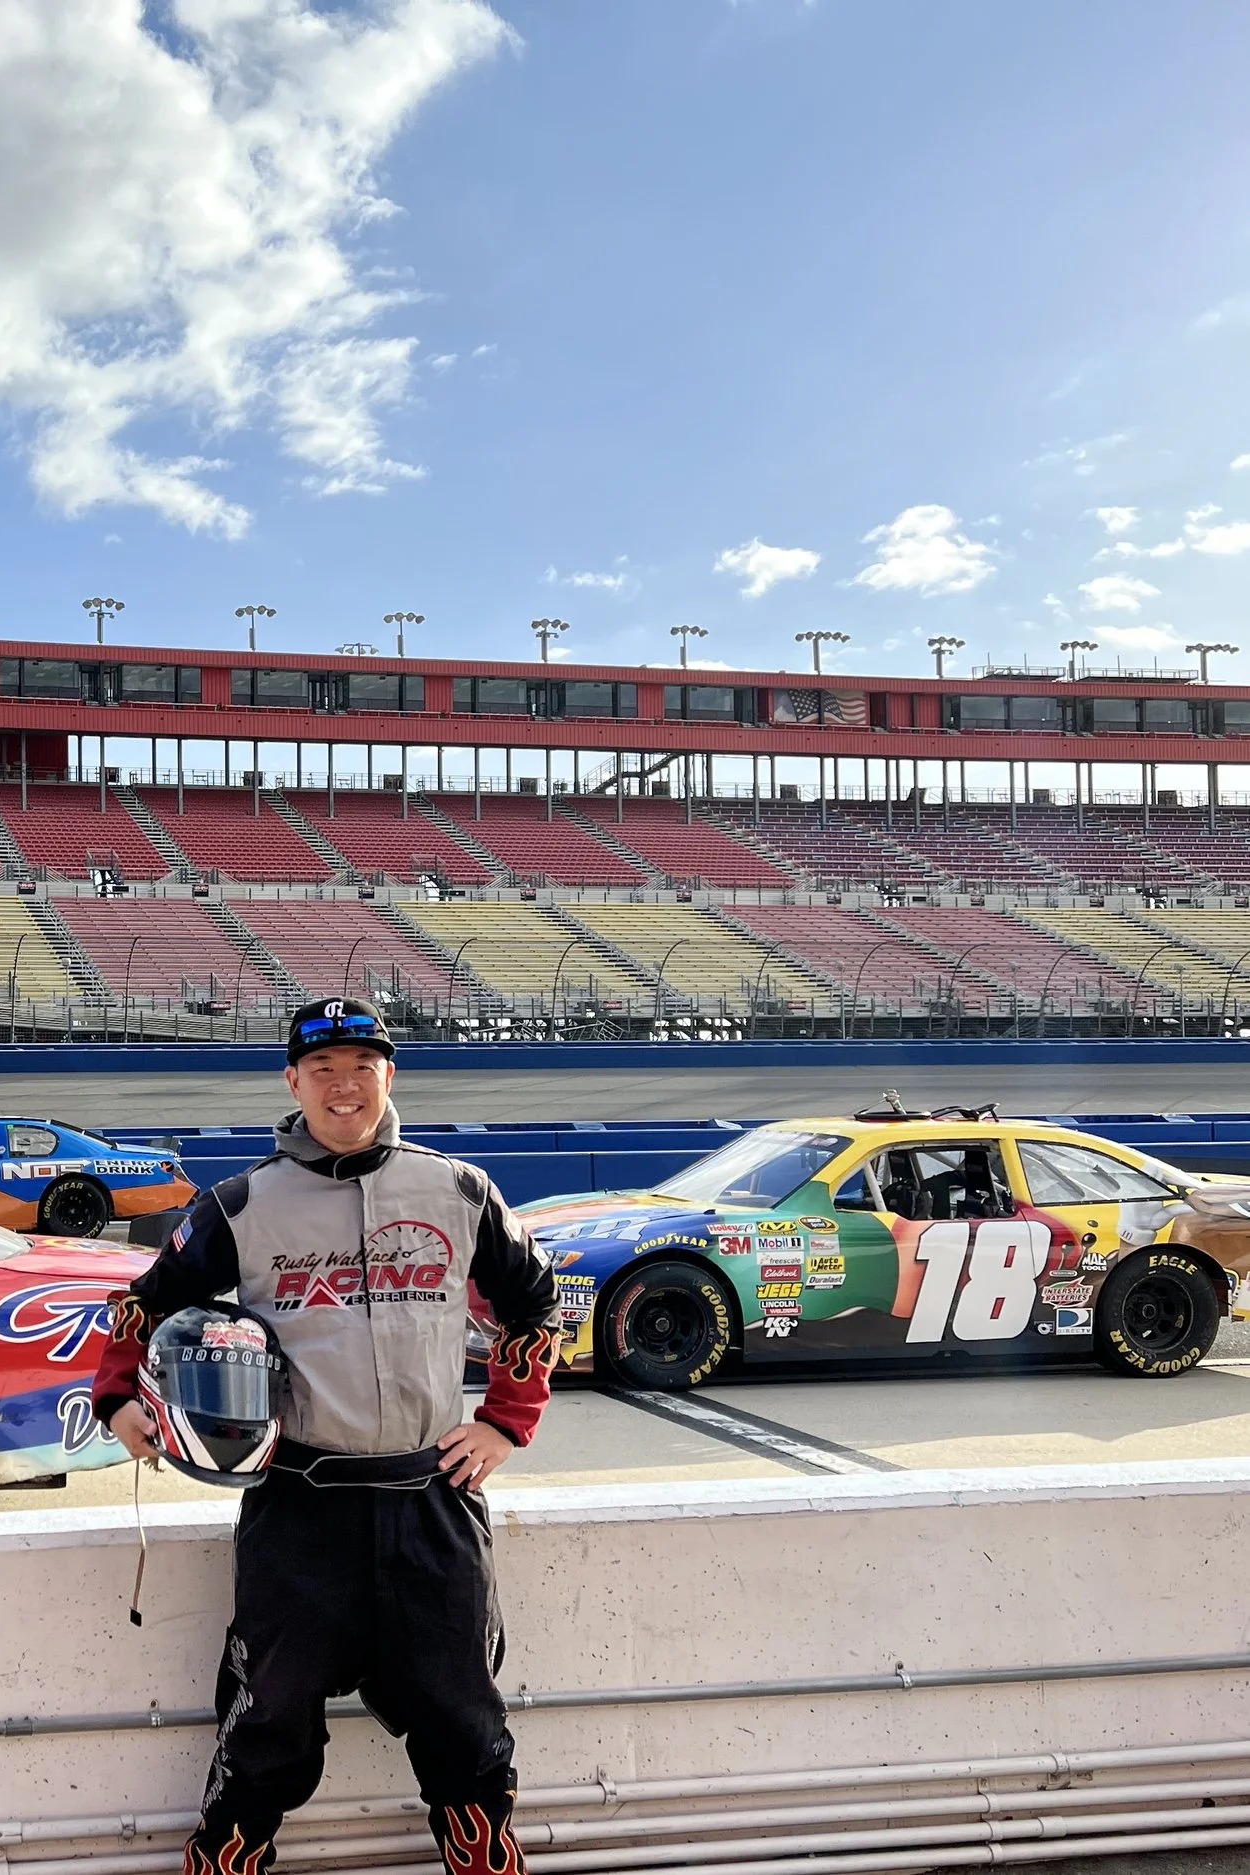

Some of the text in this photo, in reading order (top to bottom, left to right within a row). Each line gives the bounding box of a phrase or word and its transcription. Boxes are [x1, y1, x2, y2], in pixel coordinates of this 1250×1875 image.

[96, 1166, 154, 1174] DRINK
[634, 1232, 708, 1255] GOODYEAR
[720, 1236, 751, 1255] 3M
[758, 1238, 789, 1248] Mobil
[270, 1247, 400, 1272] Rusty Wallace
[1149, 1255, 1198, 1275] EAGLE
[764, 1269, 798, 1278] Edelbrock
[808, 1275, 843, 1284] Duralast
[274, 1264, 448, 1299] RACING
[905, 1221, 1053, 1344] 18
[351, 1291, 443, 1305] EXPERIENCE
[757, 1283, 803, 1298] JEGS
[564, 1292, 592, 1306] HLE
[761, 1300, 795, 1308] LINCOLN
[689, 1284, 730, 1384] GOODYEAR
